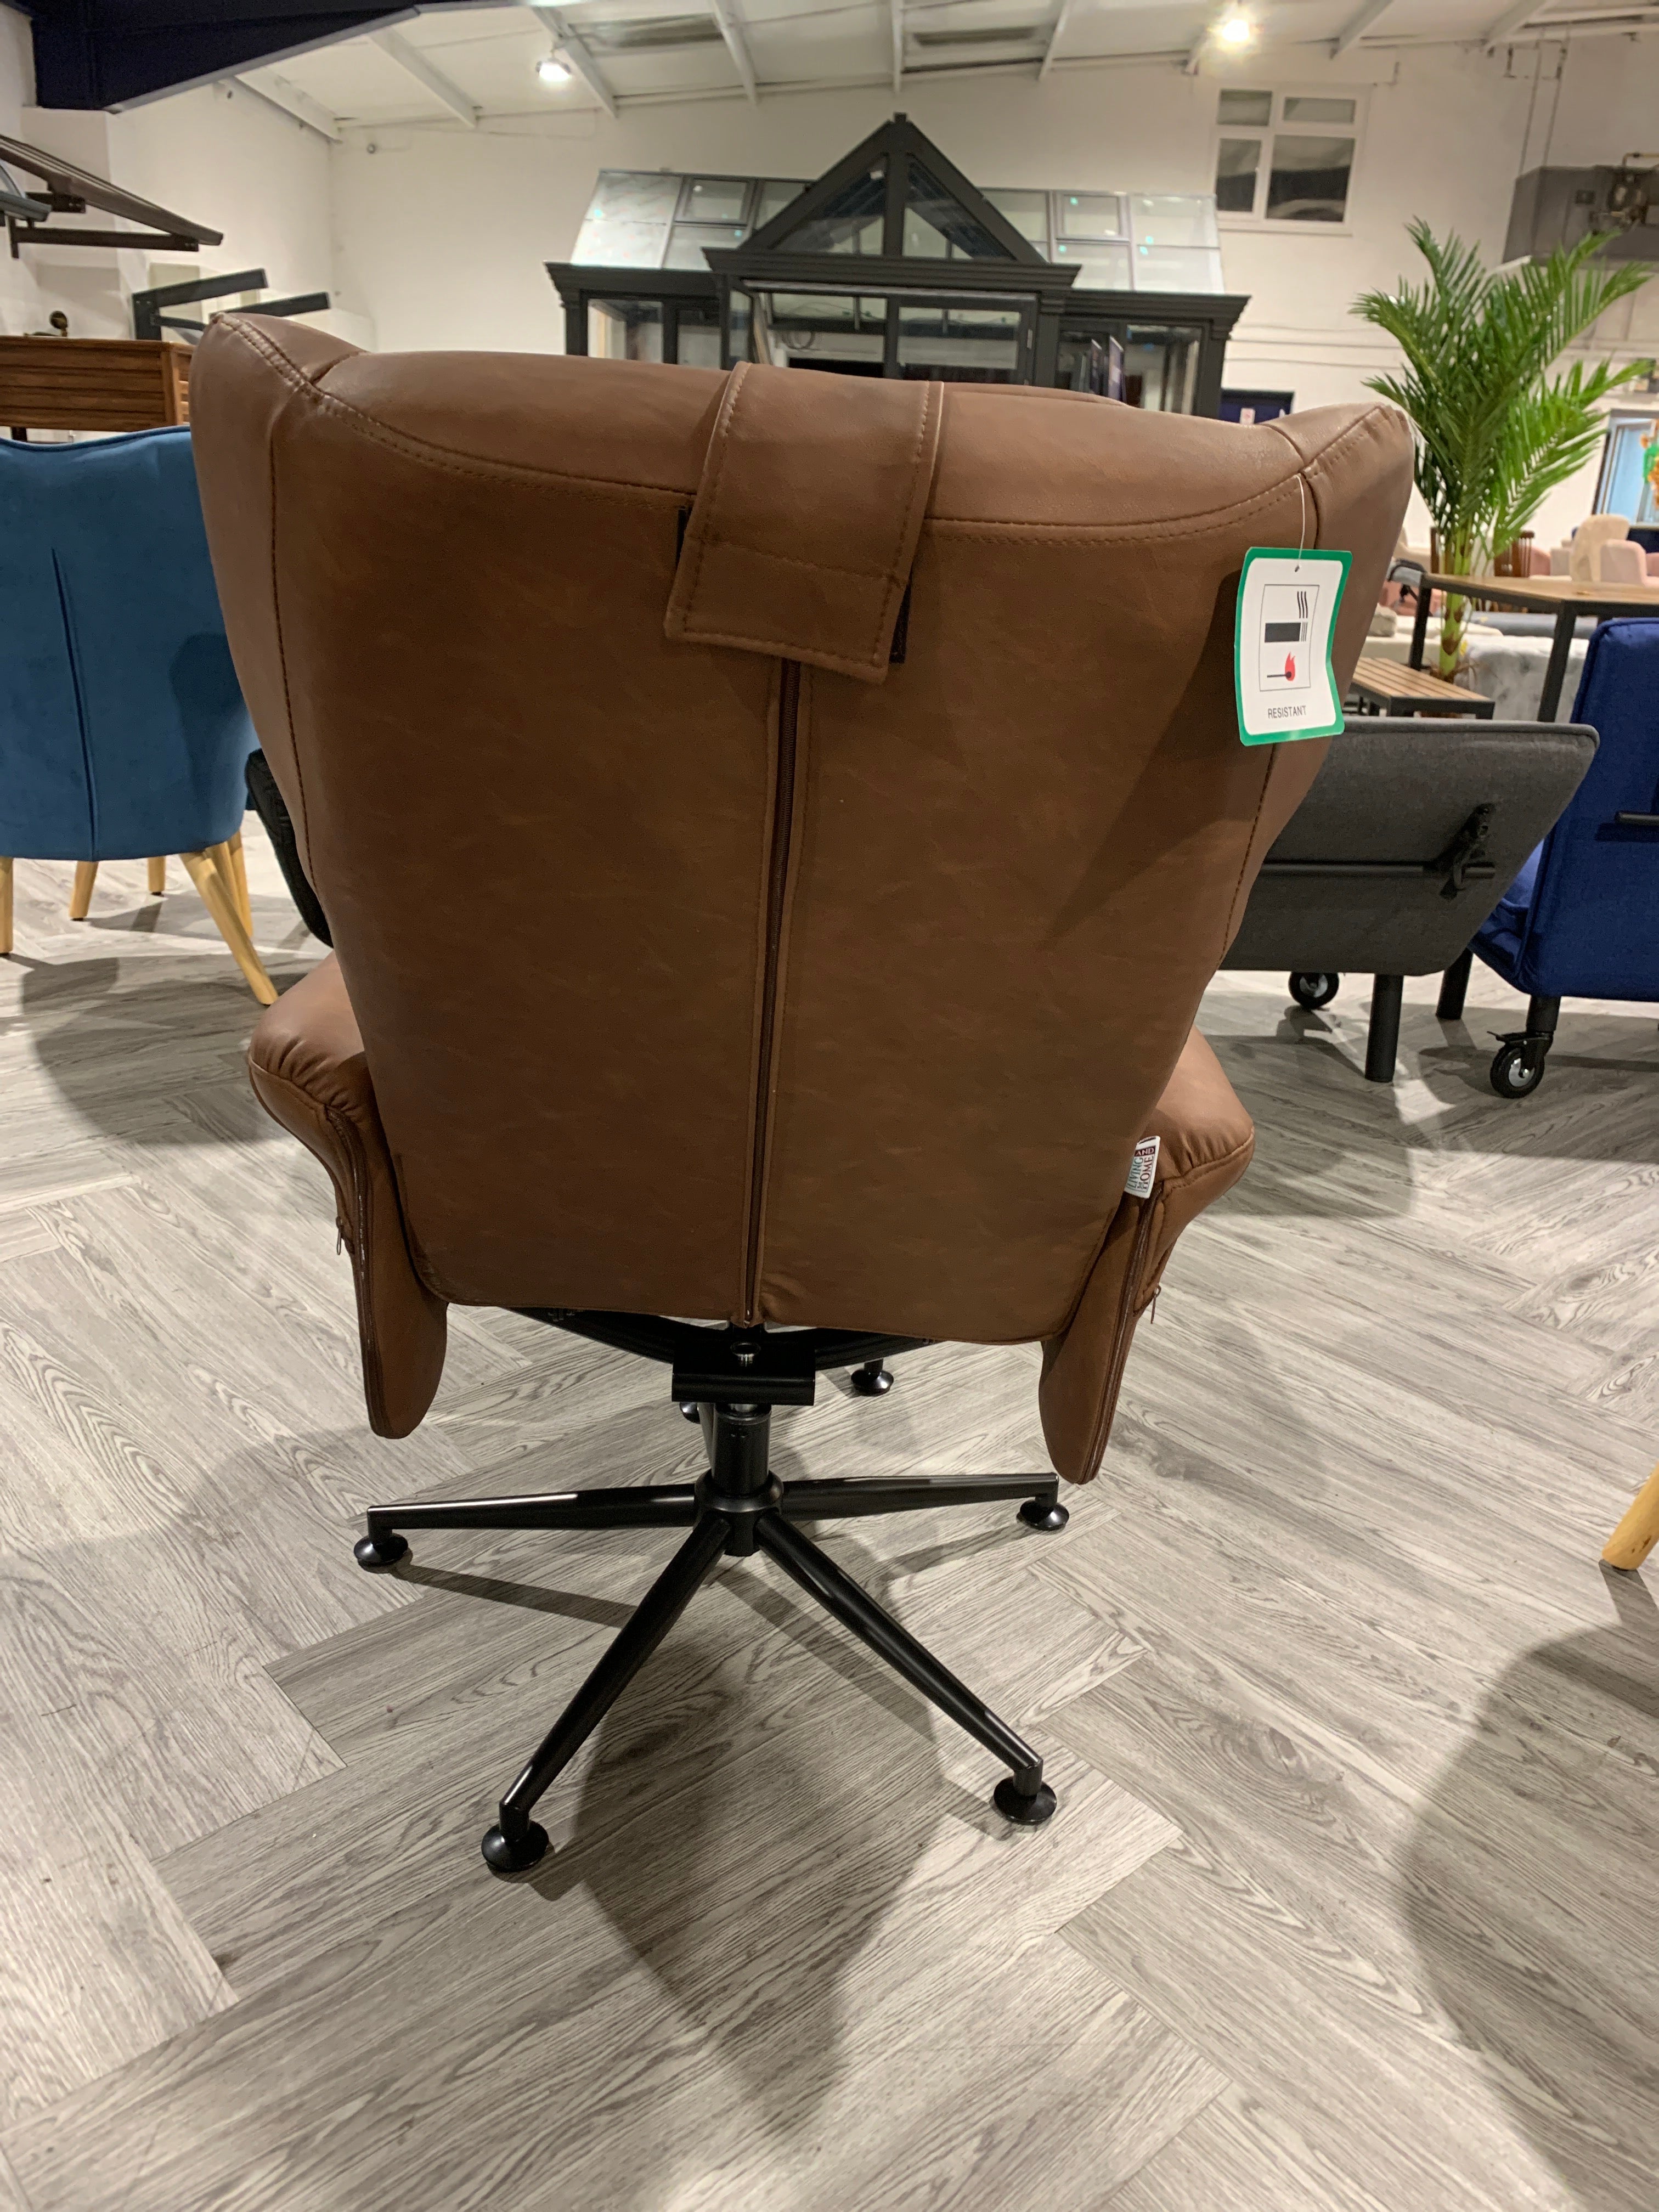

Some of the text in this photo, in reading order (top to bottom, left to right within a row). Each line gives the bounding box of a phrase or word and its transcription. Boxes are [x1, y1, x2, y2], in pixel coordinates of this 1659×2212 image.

[1267, 706, 1306, 719] RESISTANT
[1136, 1148, 1154, 1156] AND
[1127, 1157, 1144, 1189] LIVING
[1137, 1156, 1154, 1189] HOME
